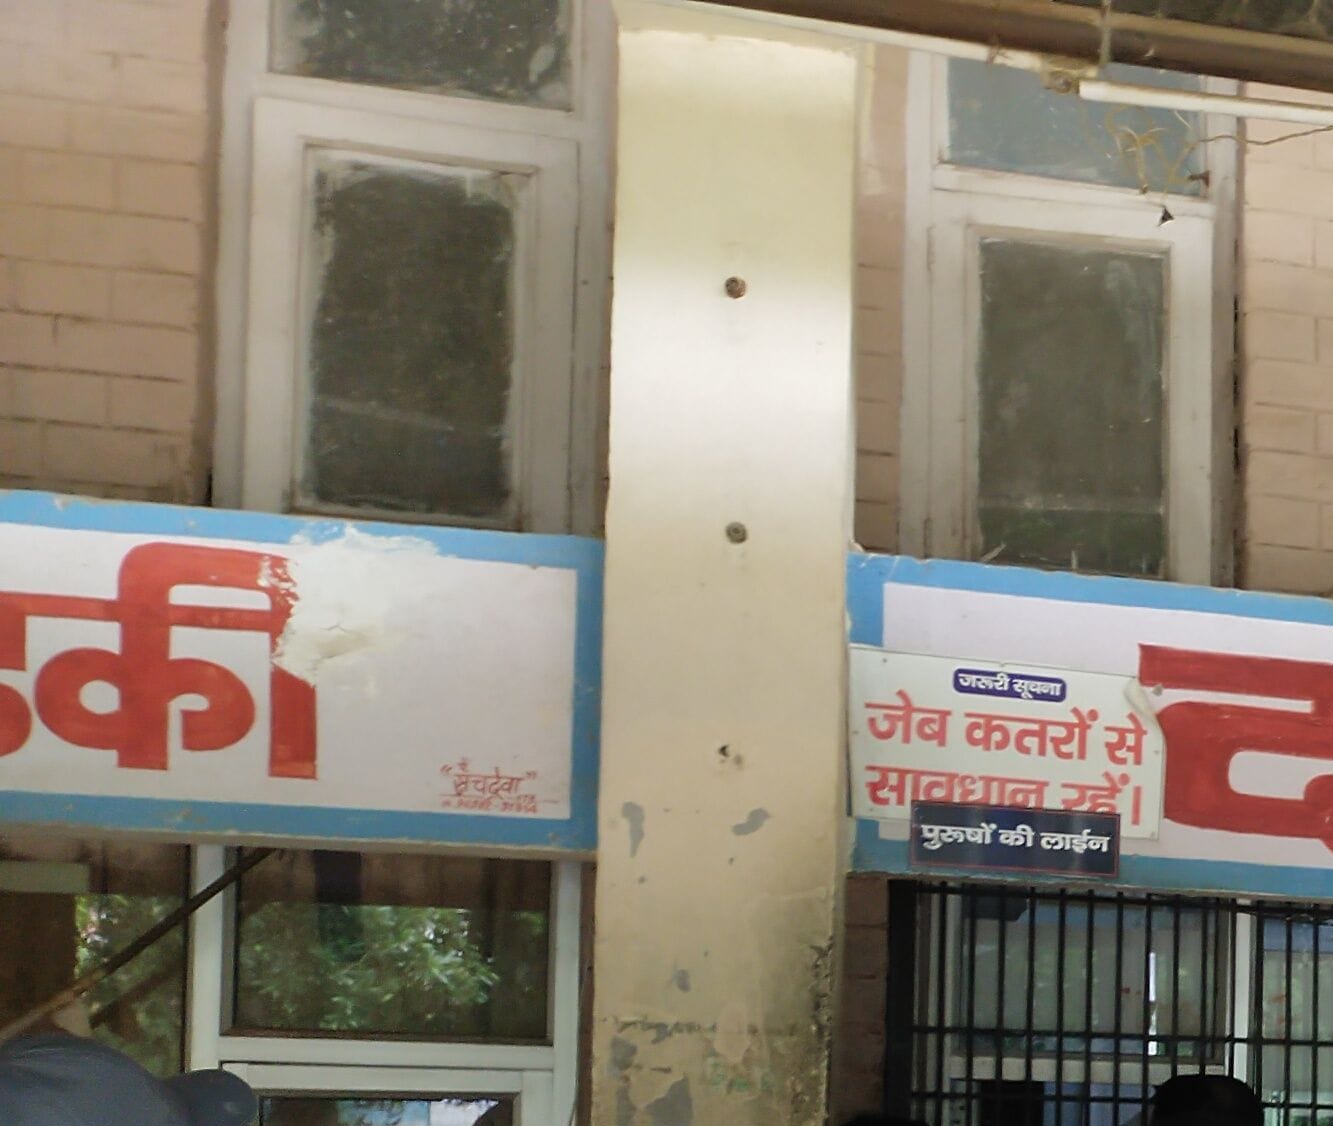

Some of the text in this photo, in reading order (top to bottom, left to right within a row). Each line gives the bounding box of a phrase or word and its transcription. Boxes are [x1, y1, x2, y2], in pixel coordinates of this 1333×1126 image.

[0, 542, 318, 780] की
[1012, 678, 1063, 700] सूचना
[865, 689, 1148, 765] जेब कतरों से
[865, 765, 1049, 808] सावधान
[999, 824, 1035, 848] की
[1040, 828, 1110, 854] लाईन
